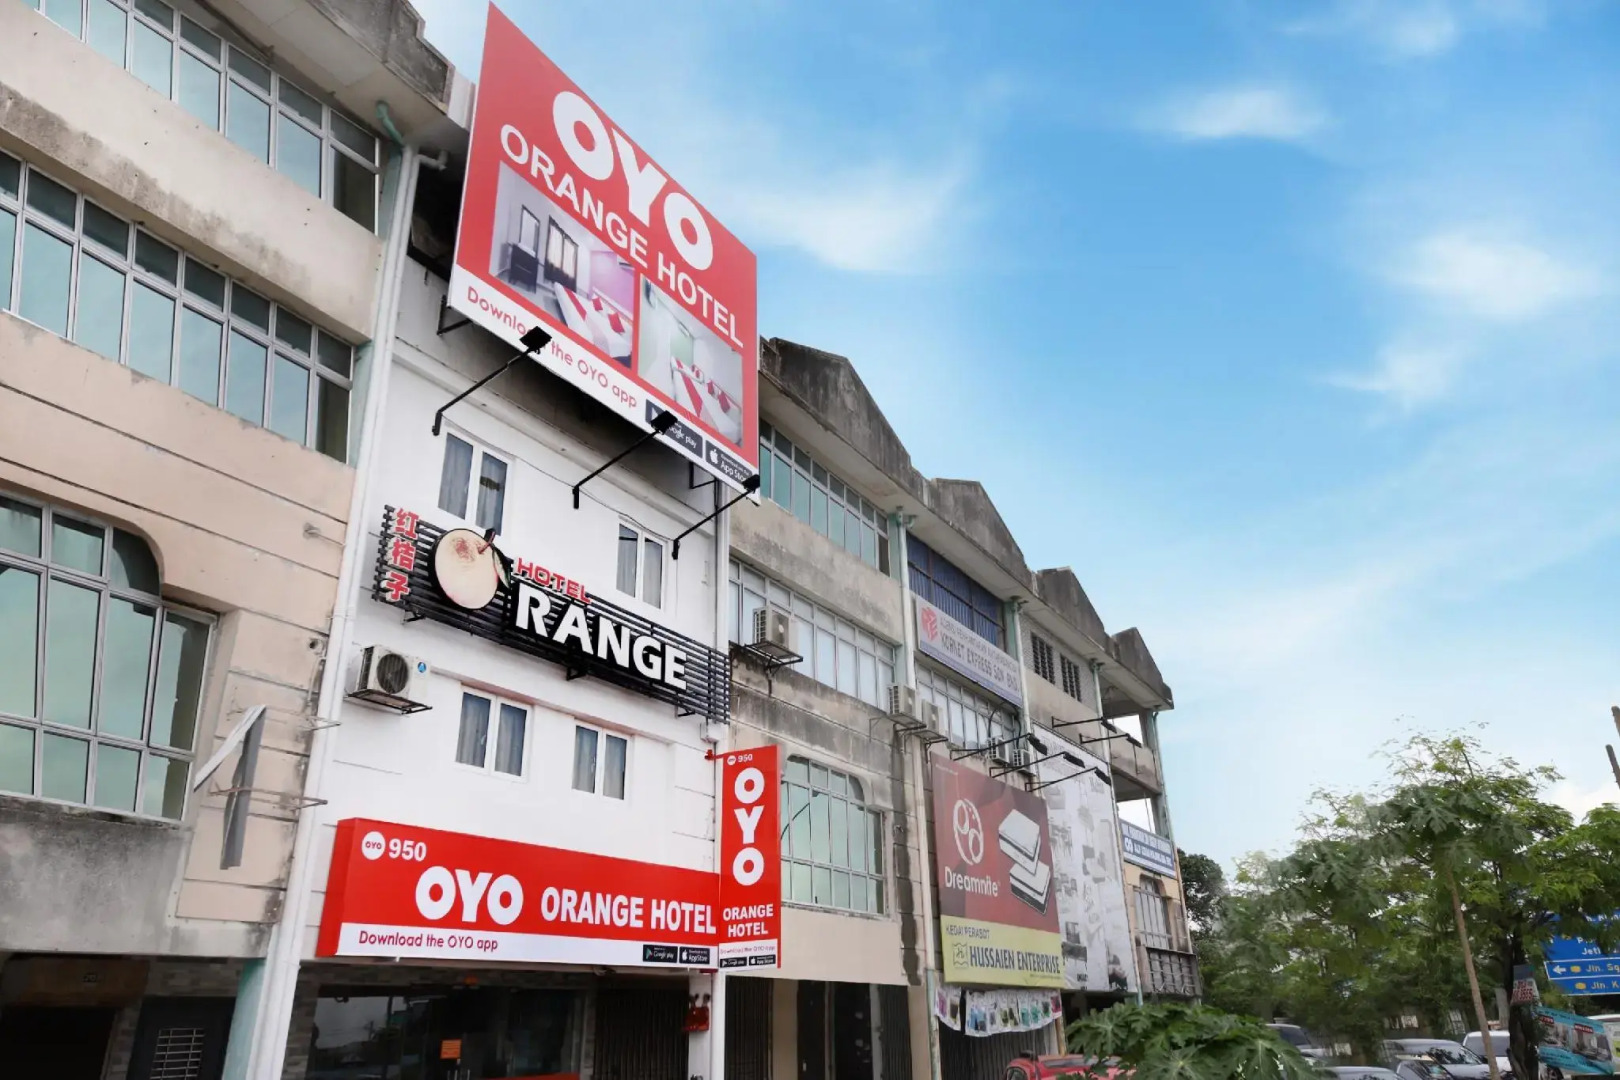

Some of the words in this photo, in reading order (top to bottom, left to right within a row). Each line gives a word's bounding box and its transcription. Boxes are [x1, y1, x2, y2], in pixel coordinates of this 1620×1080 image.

[552, 91, 713, 271] OYO
[500, 124, 649, 269] ORANGE
[658, 251, 744, 349] HOTEL
[467, 286, 547, 350] Downlo
[551, 341, 573, 366] the
[578, 355, 609, 388] OYO
[612, 384, 637, 409] app
[515, 557, 591, 604] HOTEL
[515, 583, 687, 690] RANGE
[737, 754, 753, 763] 950
[365, 840, 382, 850] OYO
[388, 838, 427, 862] 950
[732, 767, 765, 886] OYO
[415, 865, 524, 925] OYO
[540, 886, 644, 928] ORANGE
[651, 898, 716, 934] HOTEL
[722, 903, 774, 921] ORANGE
[359, 930, 423, 948] Download
[426, 934, 444, 948] the
[447, 935, 474, 949] OYO
[477, 939, 498, 952] app
[727, 921, 769, 938] HOTEL
[969, 946, 1015, 970] HUSSAIEN
[1016, 951, 1061, 974] ENTERPRISE
